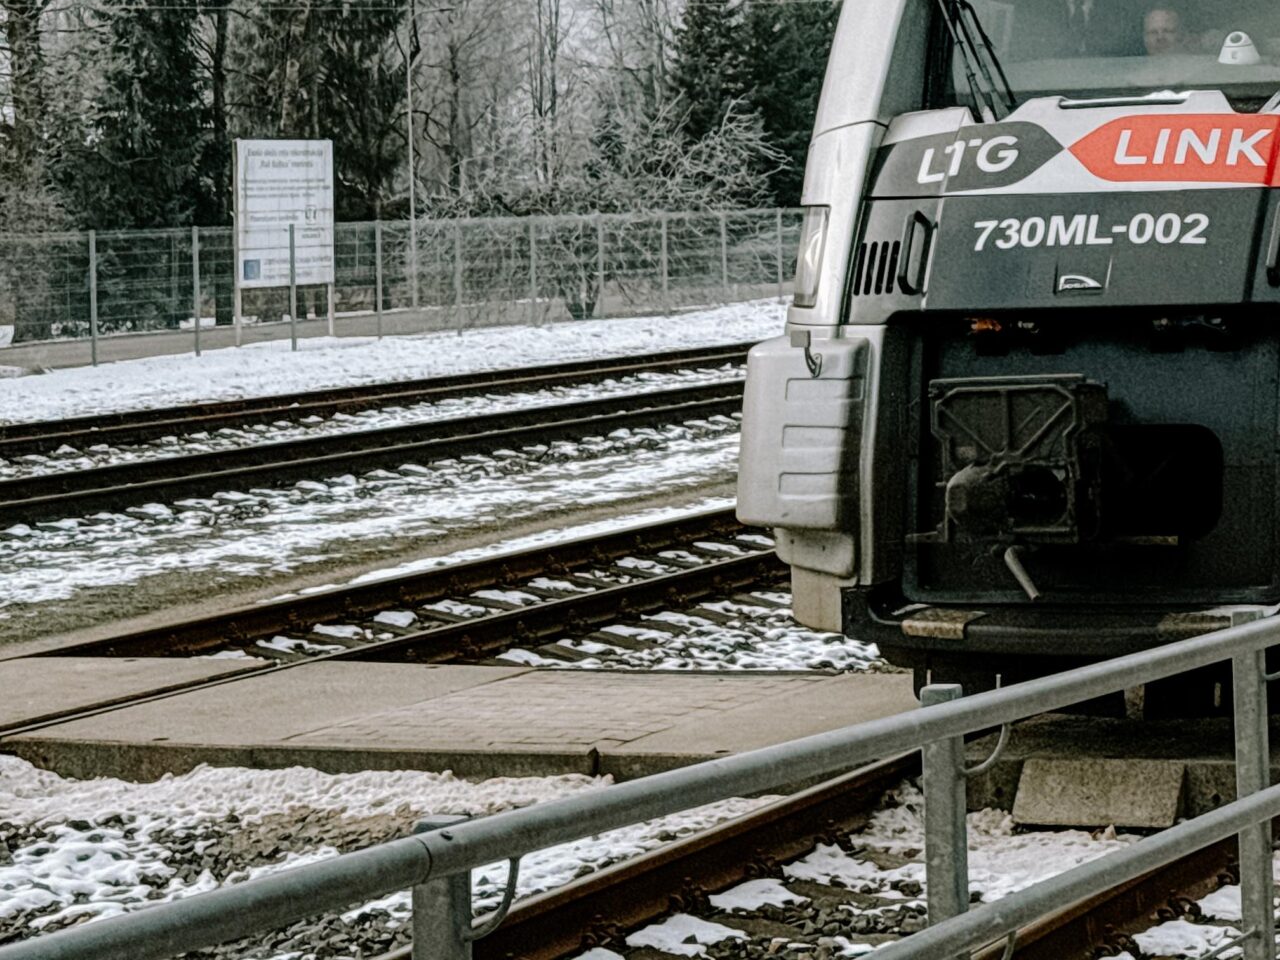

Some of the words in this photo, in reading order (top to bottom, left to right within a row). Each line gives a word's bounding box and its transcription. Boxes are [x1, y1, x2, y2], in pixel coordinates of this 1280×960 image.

[917, 135, 1019, 185] LTG
[1113, 128, 1273, 167] LINK
[973, 212, 1210, 252] 730ML-002
